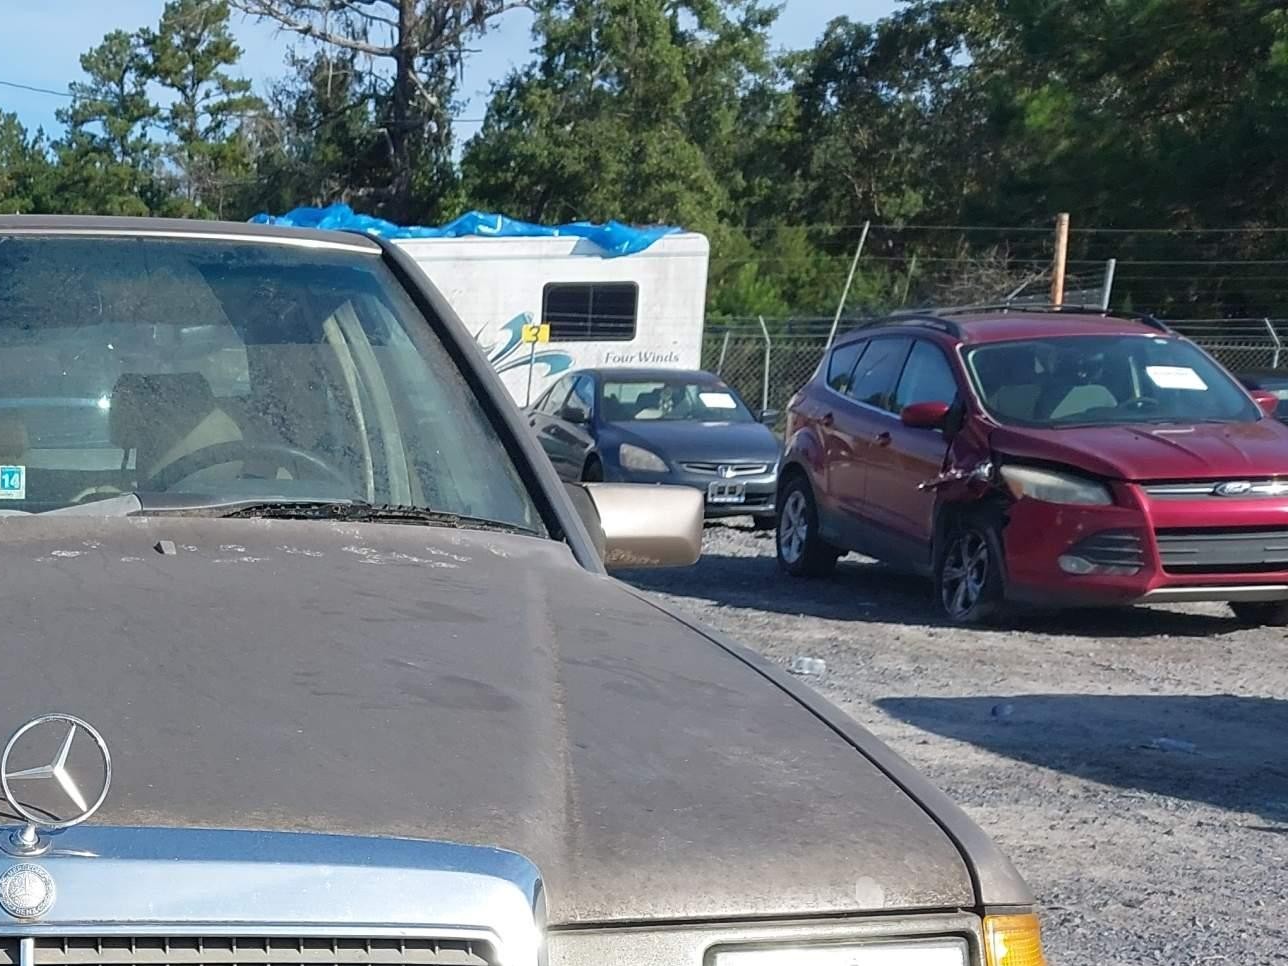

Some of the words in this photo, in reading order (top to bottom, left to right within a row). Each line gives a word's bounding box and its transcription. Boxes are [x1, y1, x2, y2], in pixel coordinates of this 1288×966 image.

[526, 325, 540, 343] 3
[604, 352, 634, 364] Four
[638, 351, 679, 363] Winds
[1, 472, 21, 489] 14
